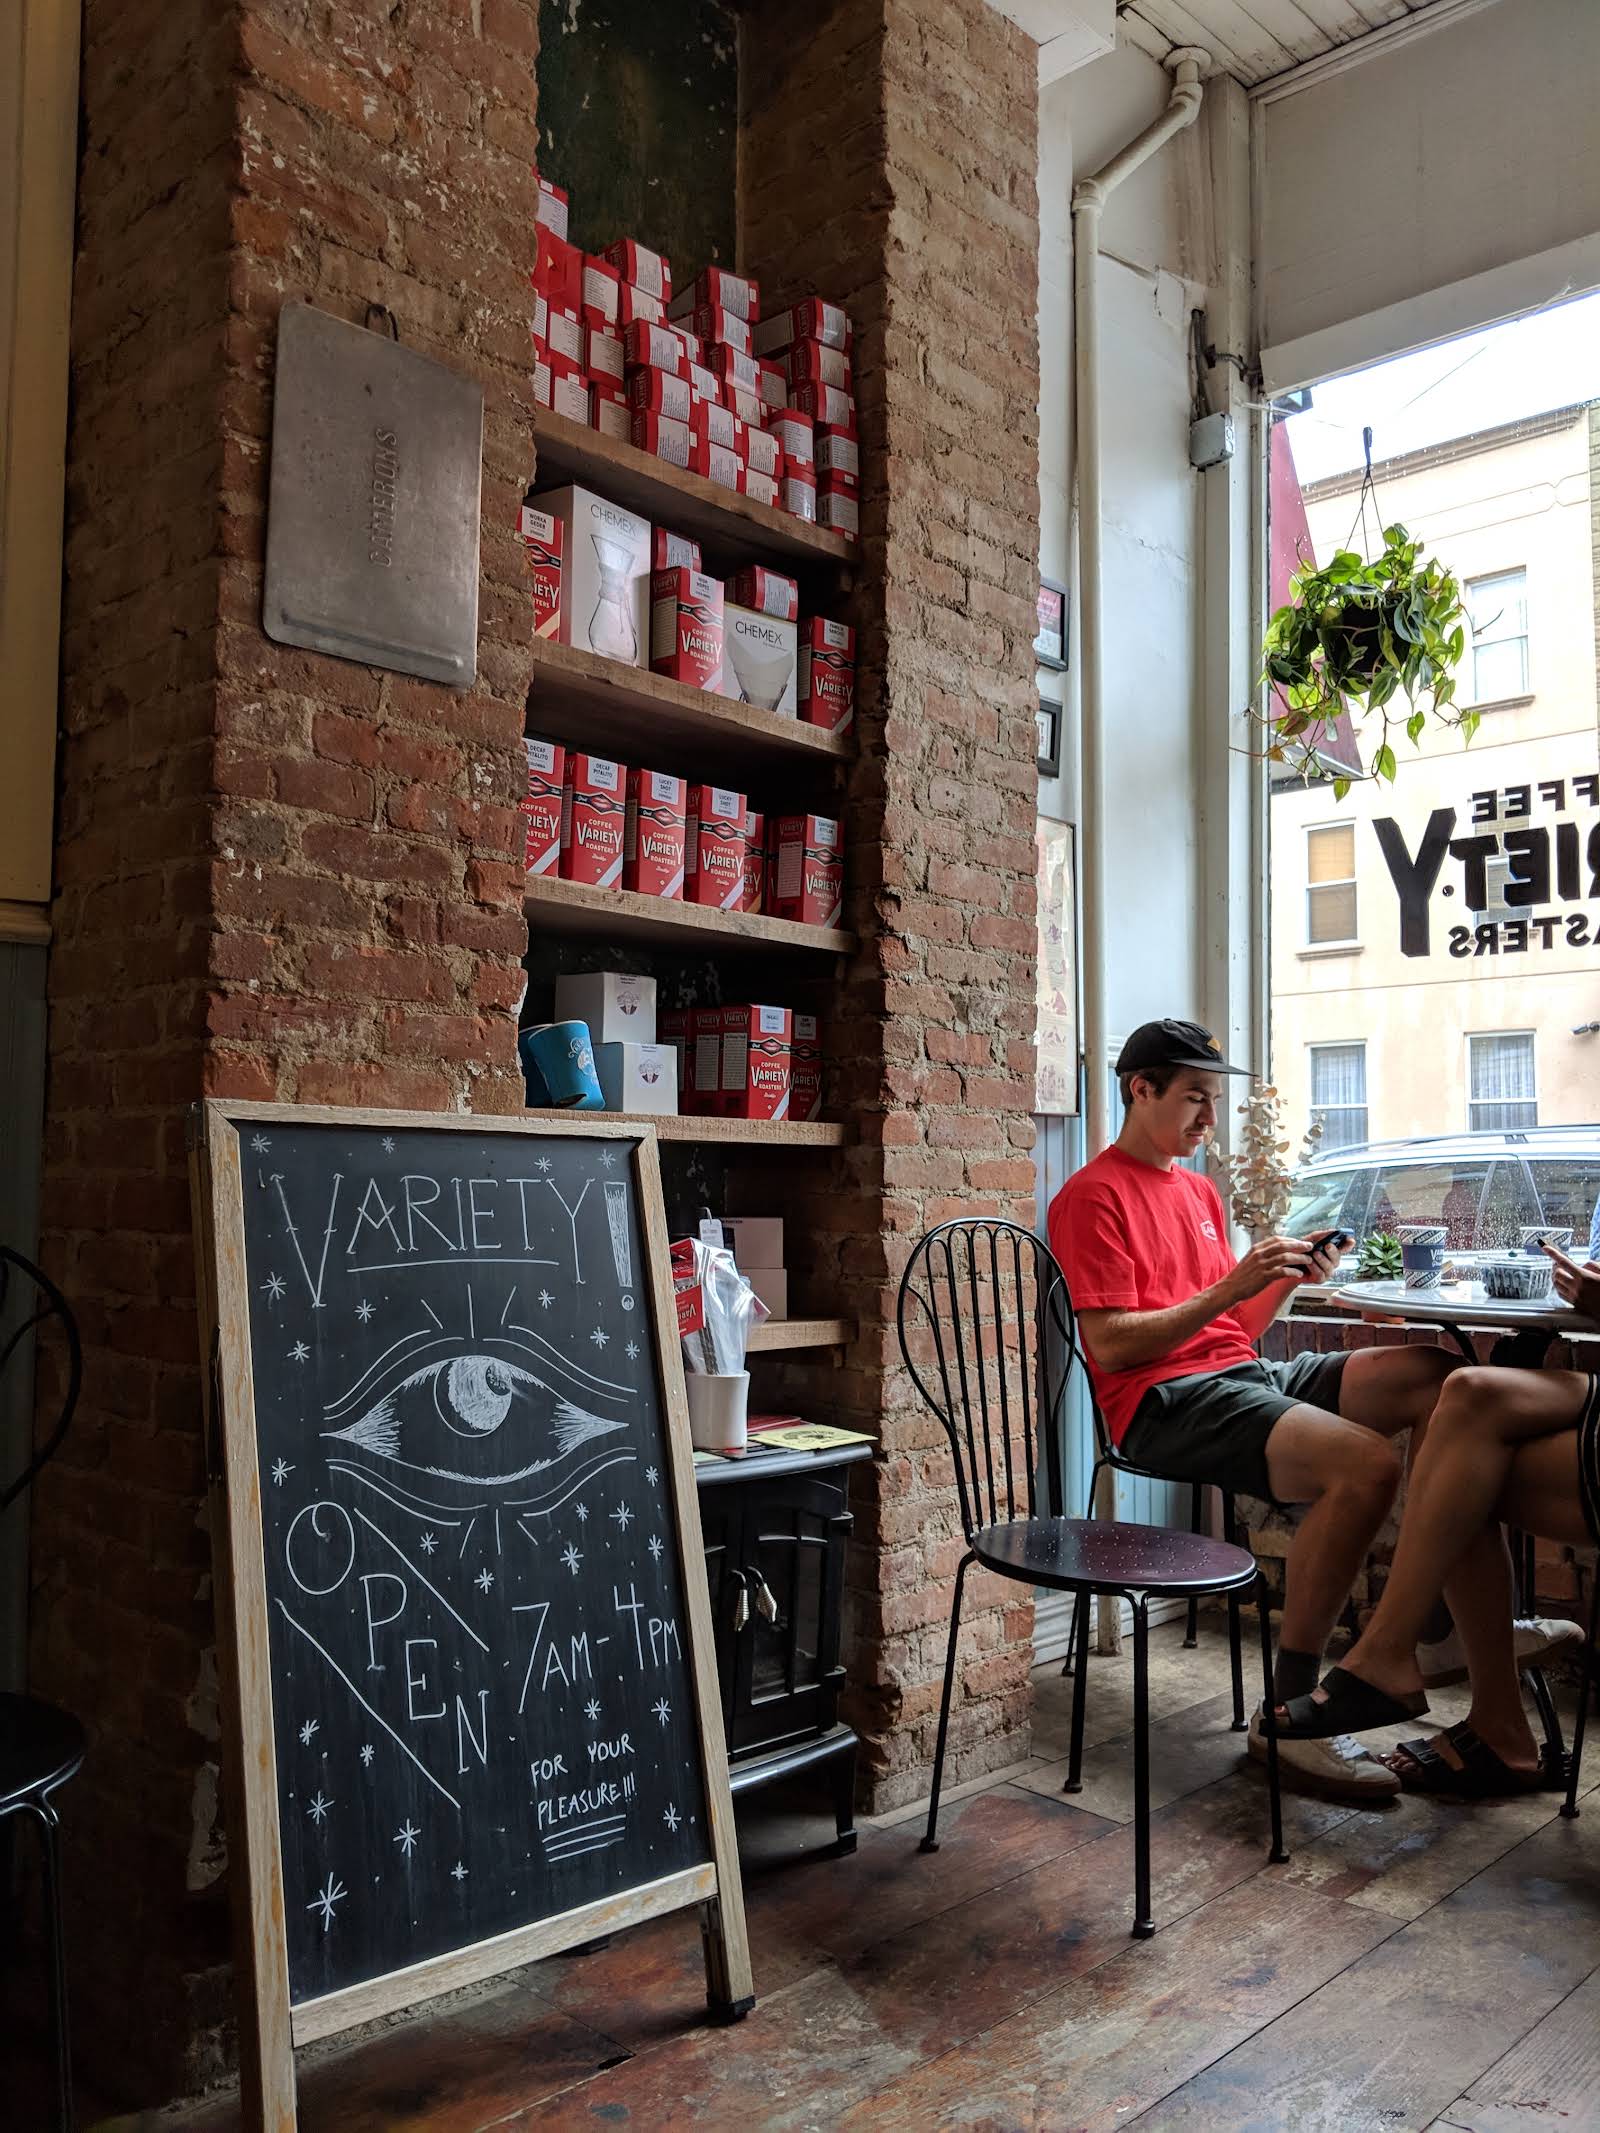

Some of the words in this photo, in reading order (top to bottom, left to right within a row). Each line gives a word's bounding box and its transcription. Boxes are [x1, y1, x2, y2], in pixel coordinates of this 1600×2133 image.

[371, 427, 400, 568] CAMERONS
[591, 503, 637, 538] CHEMEX
[692, 628, 713, 640] COFFEE
[735, 620, 782, 647] CHEMEX
[681, 629, 722, 665] VARIETY
[690, 651, 716, 665] ROASTERS
[815, 676, 853, 705] VARIETY
[596, 763, 610, 771] DECAF
[658, 778, 672, 786] LUCKY
[660, 784, 672, 792] SHOT
[719, 794, 732, 802] LUCKY
[520, 803, 547, 814] COFFEE
[589, 818, 612, 829] COFFEE
[577, 821, 623, 854] VARIETY
[653, 832, 674, 843] COFFEE
[585, 842, 614, 854] ROASTERS
[642, 834, 684, 865] VARIETY
[713, 845, 734, 855] COFFEE
[650, 855, 676, 866] ROASTERS
[702, 848, 744, 878] VARIETY
[711, 868, 736, 879] ROASTERS
[806, 873, 842, 899] VARIETY
[761, 1061, 781, 1069] COFFEE
[751, 1065, 789, 1089] VARIETY
[759, 1082, 782, 1091] ROASTERS
[270, 1173, 634, 1311] VARIETY!
[286, 1501, 490, 1774] OPEN
[531, 1754, 568, 1787] FOR
[587, 1733, 635, 1763] YOUR
[537, 1772, 638, 1830] PLEASURE!!!
